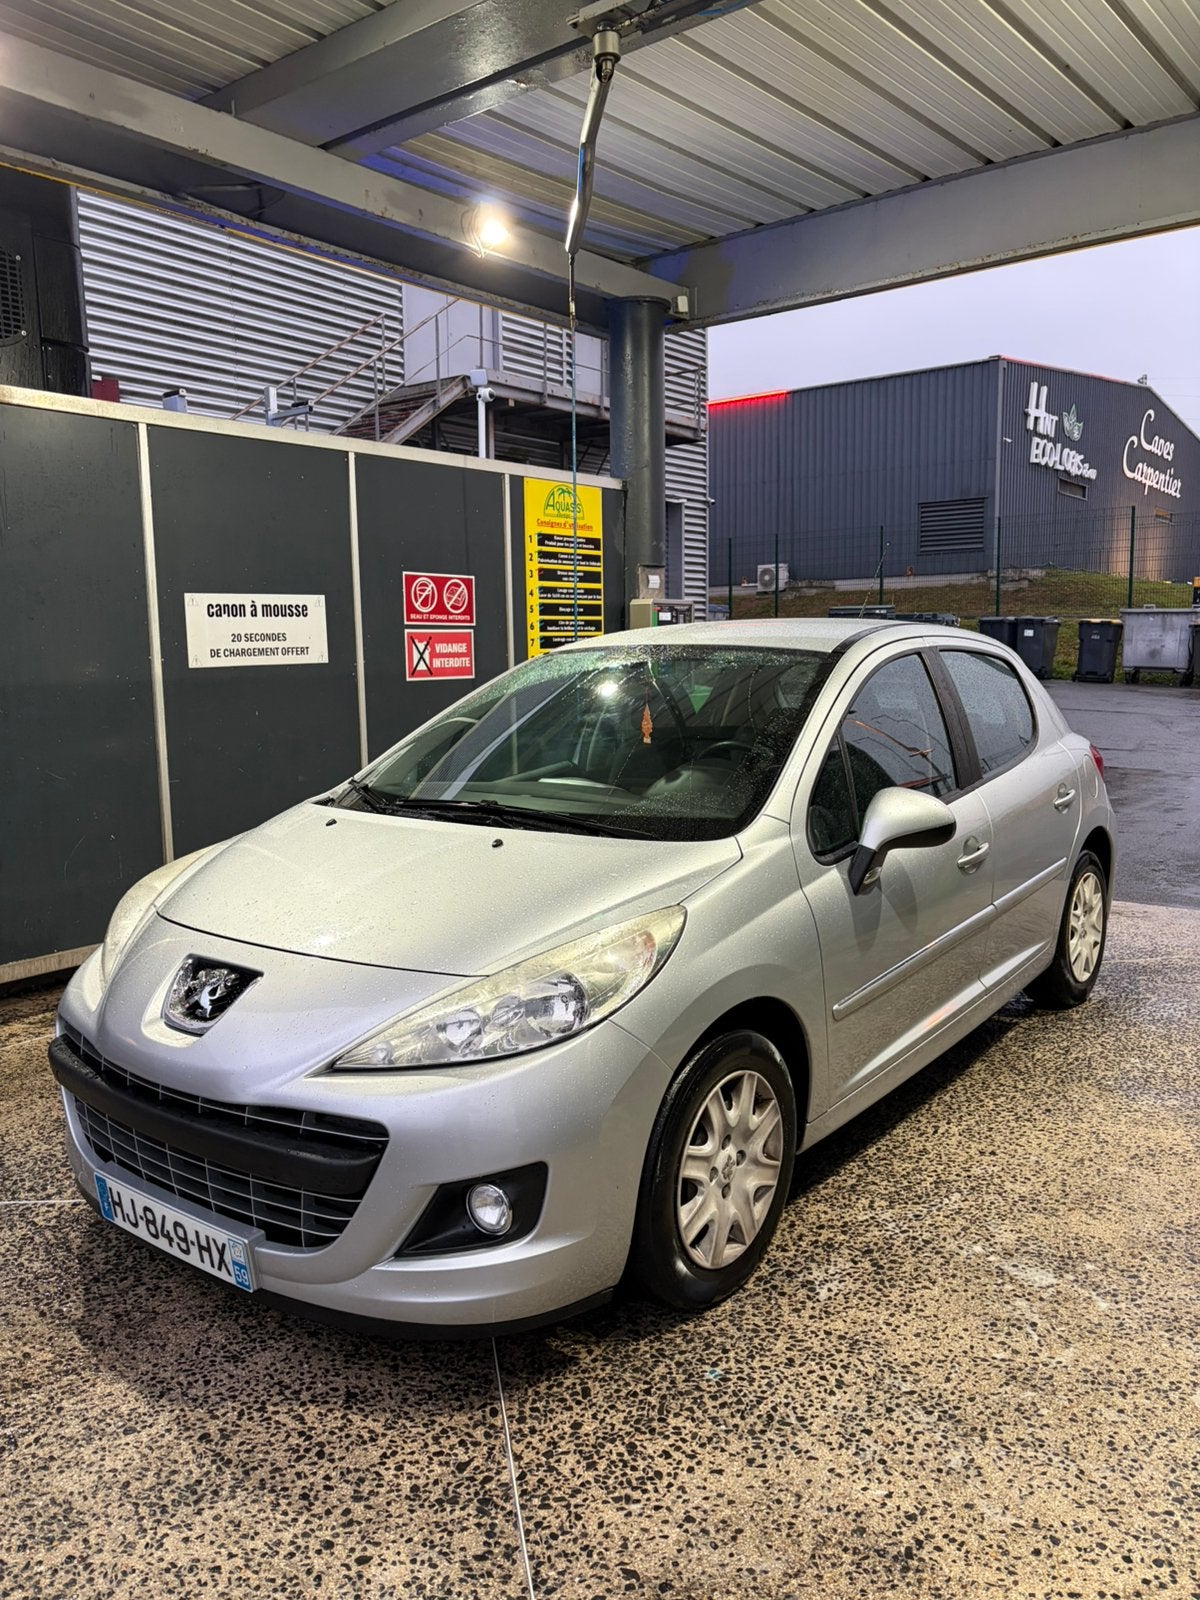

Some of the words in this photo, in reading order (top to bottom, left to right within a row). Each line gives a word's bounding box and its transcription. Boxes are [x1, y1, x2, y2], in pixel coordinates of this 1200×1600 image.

[1140, 409, 1175, 461] Caves
[1123, 435, 1182, 498] Carpentier
[545, 489, 582, 514] AQUASS
[536, 518, 562, 528] Consignes
[529, 535, 533, 543] 1
[529, 553, 533, 562] 2
[529, 570, 533, 578] 3
[529, 589, 533, 597] 4
[207, 603, 246, 618] canon
[250, 600, 258, 618] à
[261, 604, 308, 618] mousse
[529, 605, 534, 613] 5
[529, 623, 535, 631] 6
[231, 633, 242, 643] 20
[244, 632, 287, 643] SECONDES
[435, 643, 467, 653] VIDANGE
[529, 639, 535, 647] 7
[210, 649, 221, 658] DE
[223, 647, 279, 657] CHARGEMENT
[281, 646, 309, 656] OFFERT
[432, 657, 471, 668] INTERDITE
[109, 1187, 232, 1277] HJ-849-HX
[234, 1265, 249, 1286] 59
